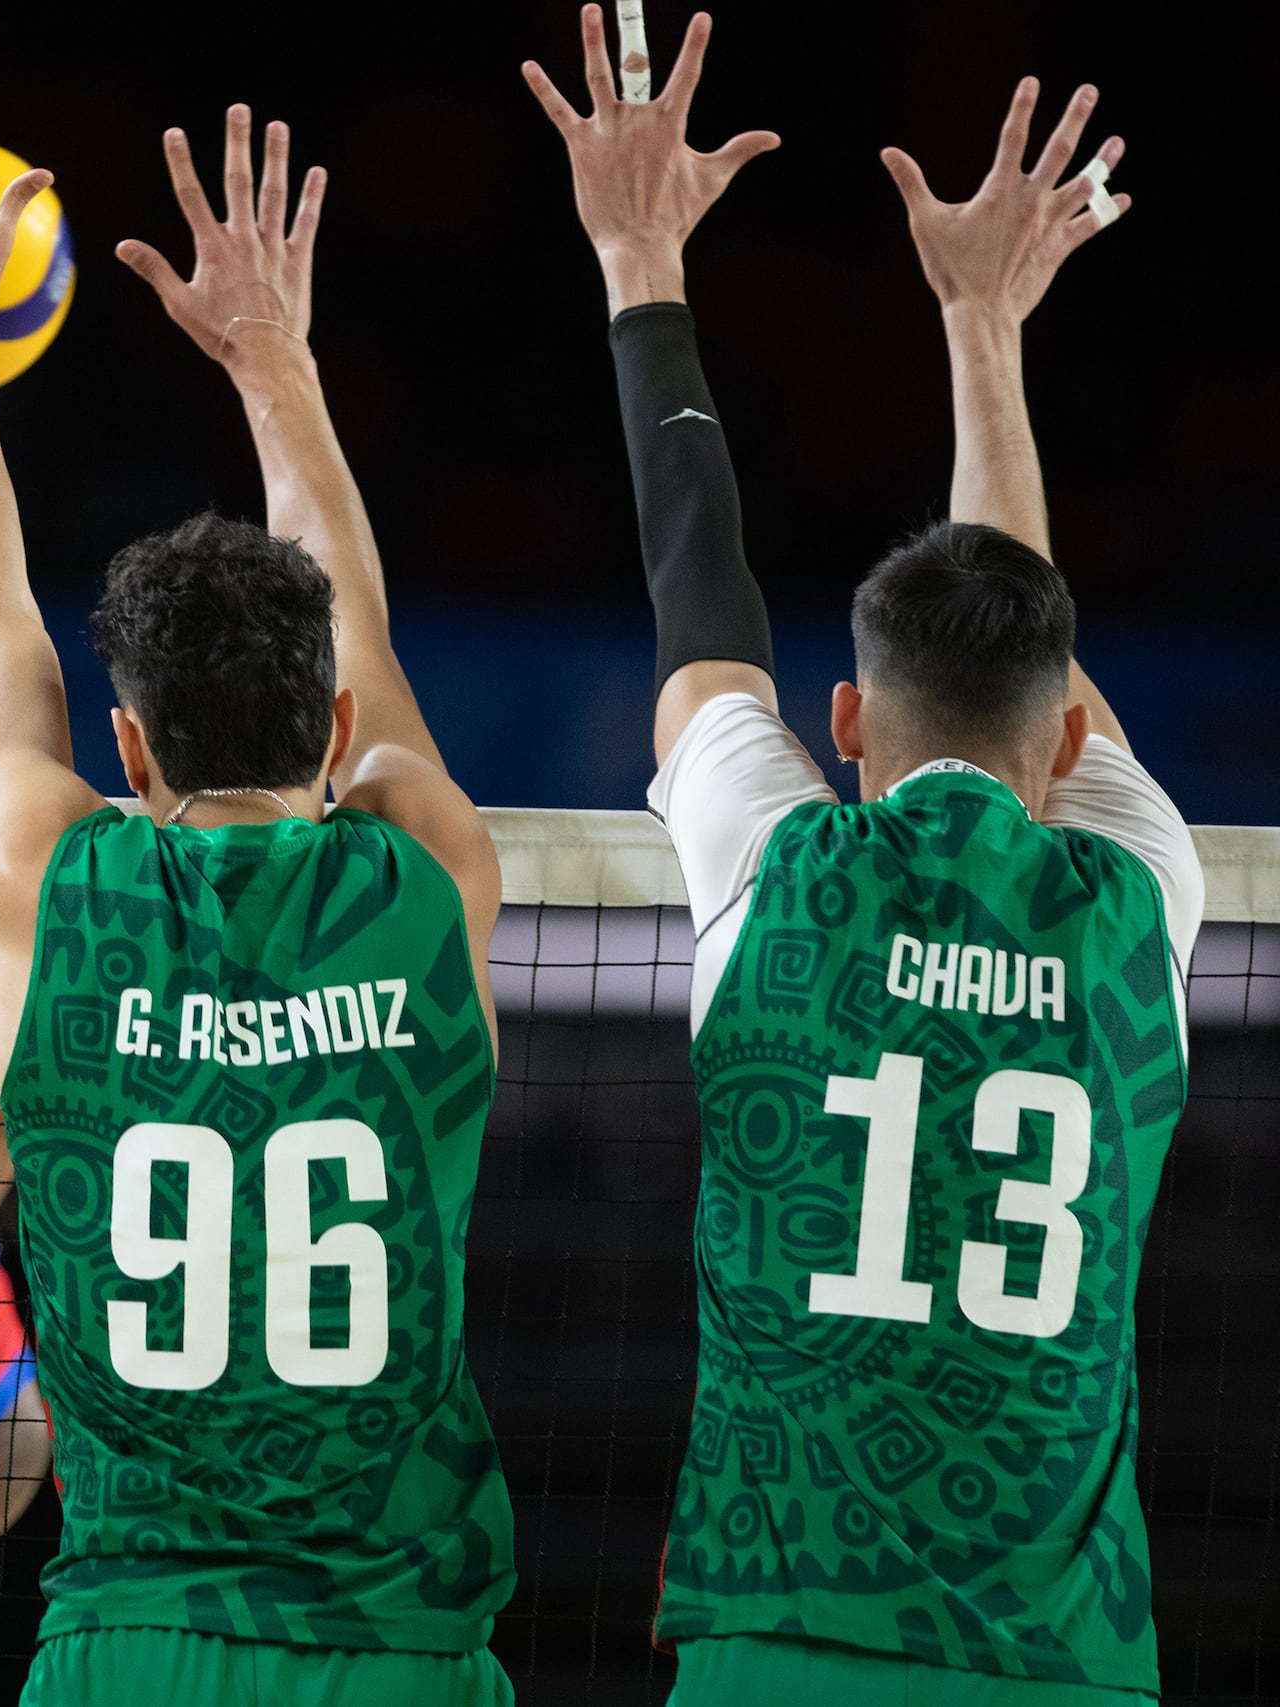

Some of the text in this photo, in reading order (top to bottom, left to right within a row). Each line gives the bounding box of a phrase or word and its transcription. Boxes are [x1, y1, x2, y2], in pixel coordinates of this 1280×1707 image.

[115, 977, 416, 1067] G. RESENDIZ
[886, 933, 1066, 1022] CHAVA
[106, 1118, 389, 1391] 96
[808, 1051, 1092, 1339] 13
